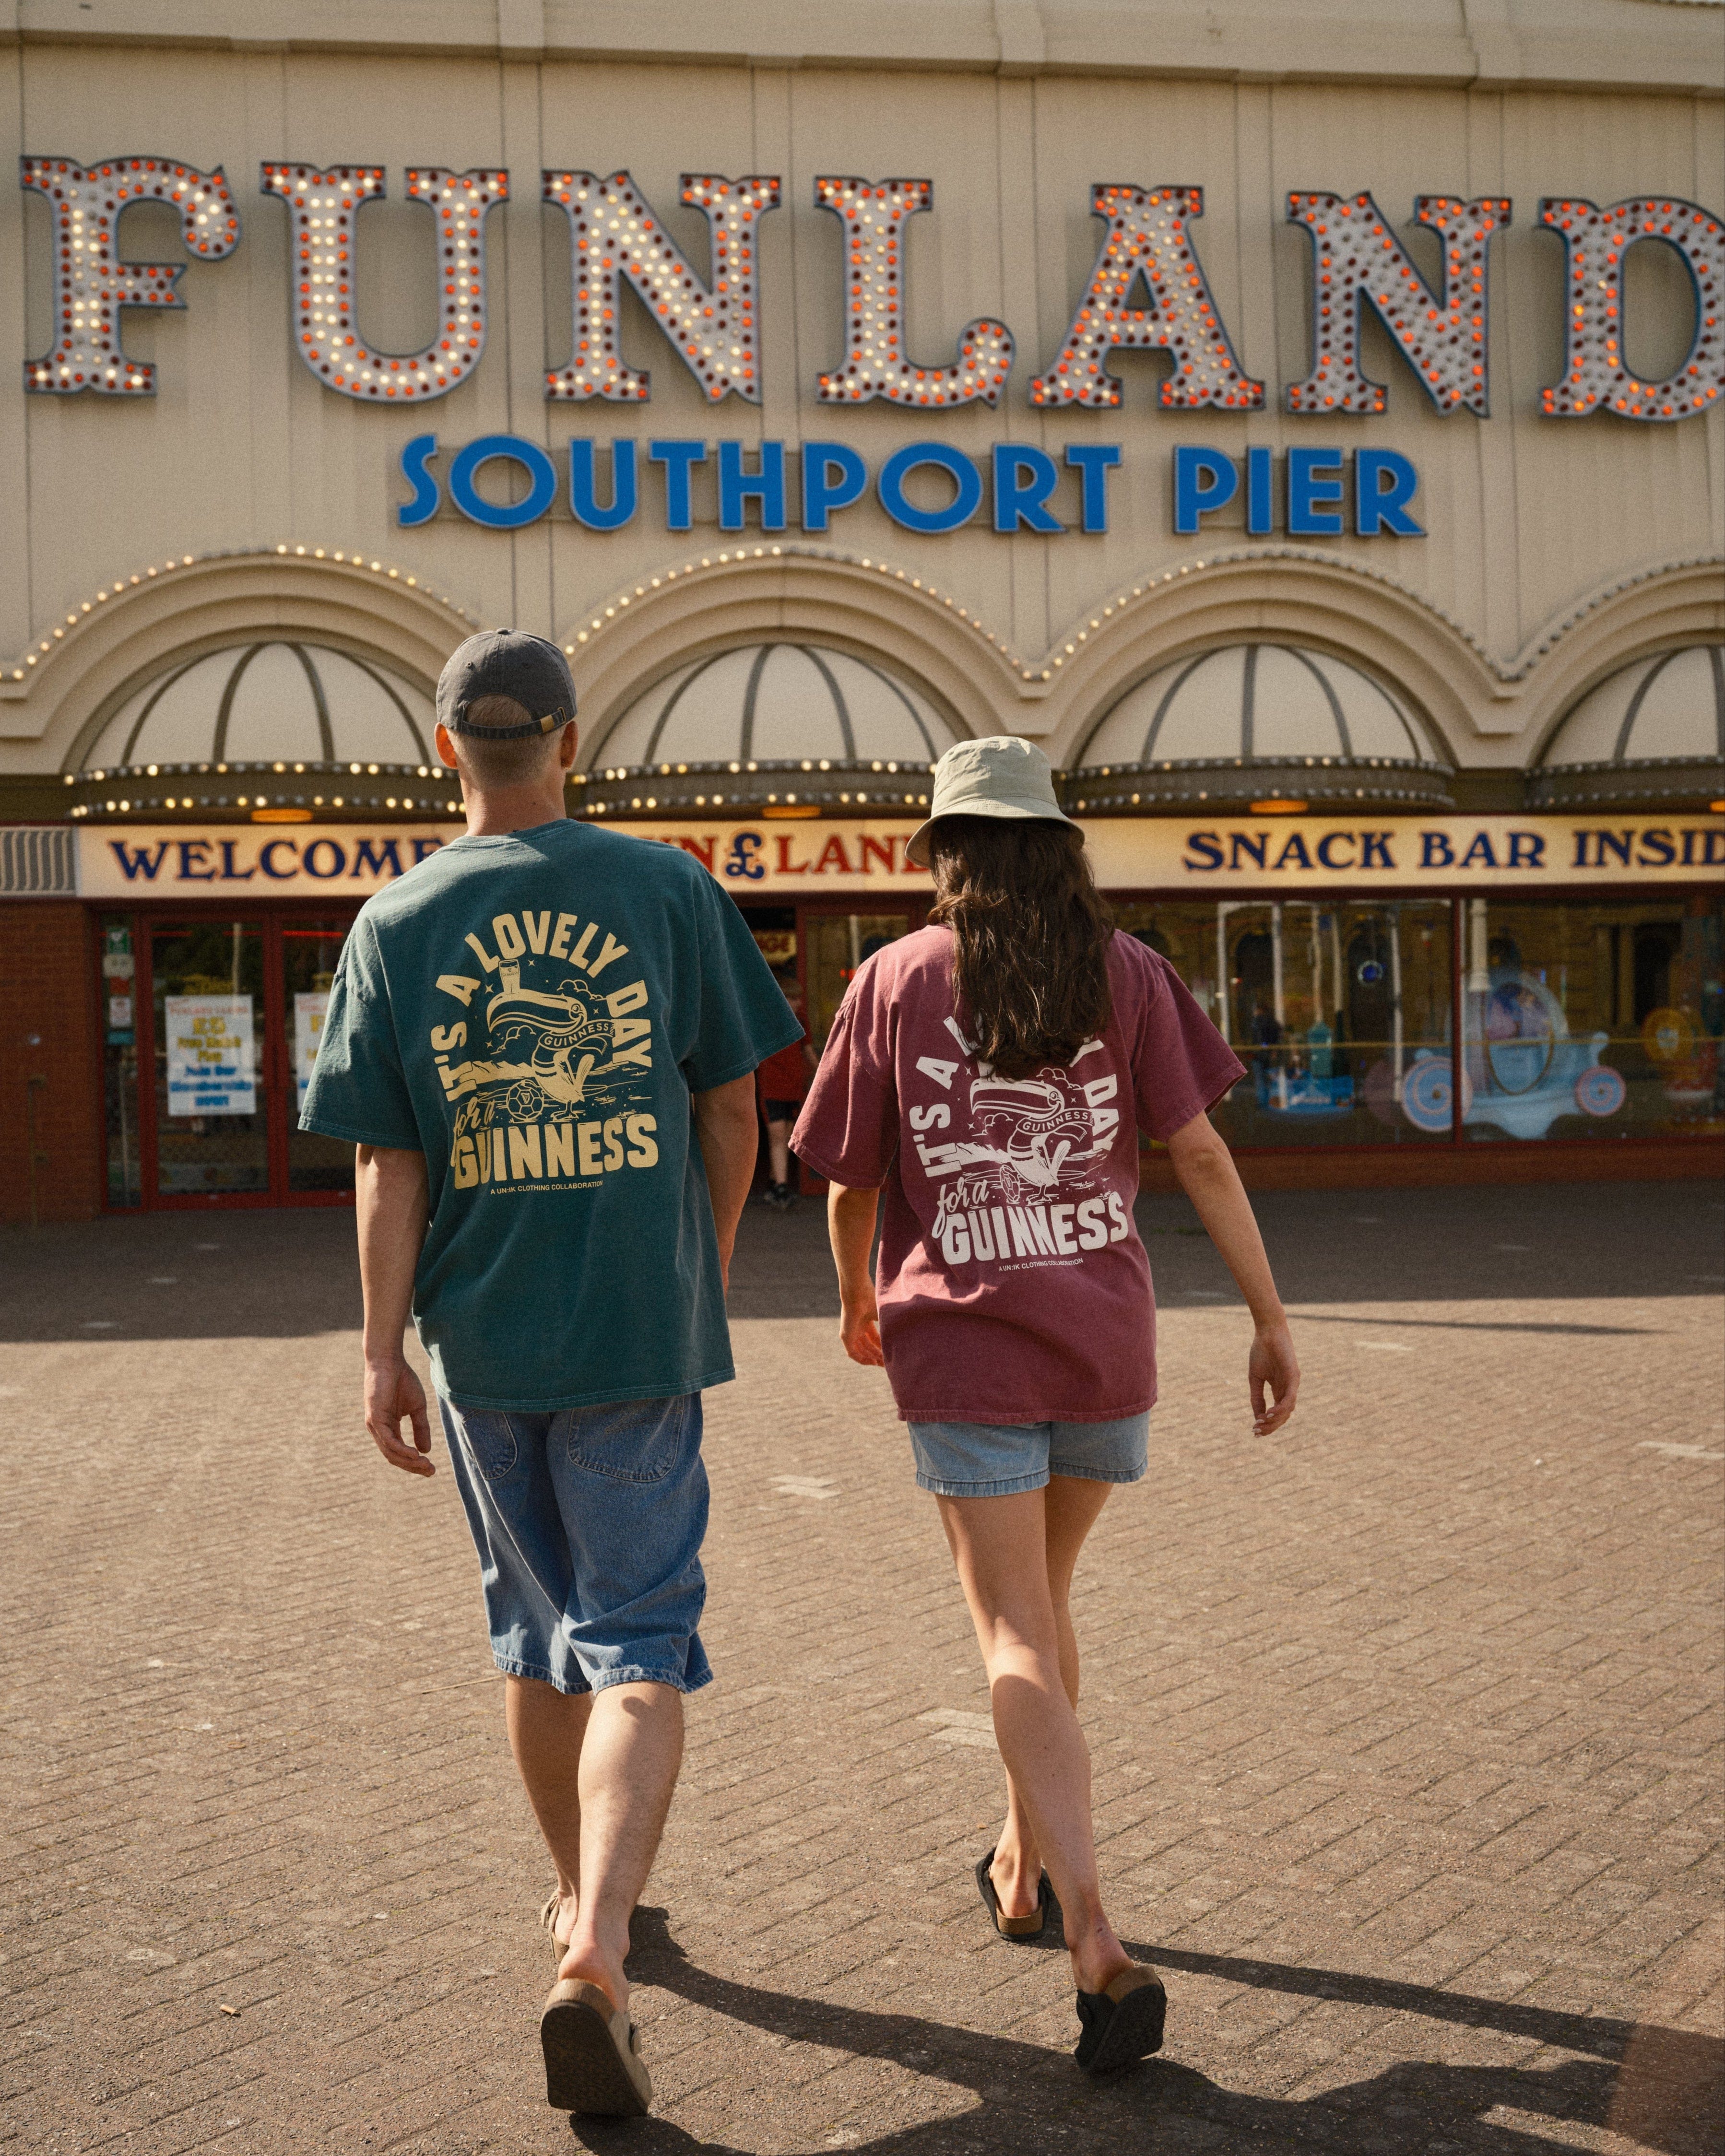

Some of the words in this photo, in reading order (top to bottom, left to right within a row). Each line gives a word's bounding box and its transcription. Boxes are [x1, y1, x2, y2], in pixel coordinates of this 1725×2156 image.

[20, 155, 1725, 421] FUNLAND
[398, 434, 1122, 533] SOUTHPORT
[1173, 445, 1426, 536] PIER
[1183, 831, 1397, 871] SNACK
[1418, 830, 1547, 869] BAR
[464, 911, 629, 978] LOVELY
[436, 975, 481, 1006] A
[606, 980, 652, 1067] DAY
[431, 1022, 477, 1102] IT'S
[544, 1023, 609, 1047] GUINNESS
[916, 1056, 959, 1090] A
[910, 1104, 962, 1178] IT'S
[1023, 1112, 1088, 1132] GUINNESS
[1084, 1074, 1119, 1152] DAY
[454, 1113, 659, 1190] GUINNESS
[496, 1186, 516, 1194] UN:IK
[551, 1180, 603, 1190] COLLABORATION
[941, 1191, 1129, 1265] GUINNESS
[1021, 1261, 1048, 1269] CLOTHING
